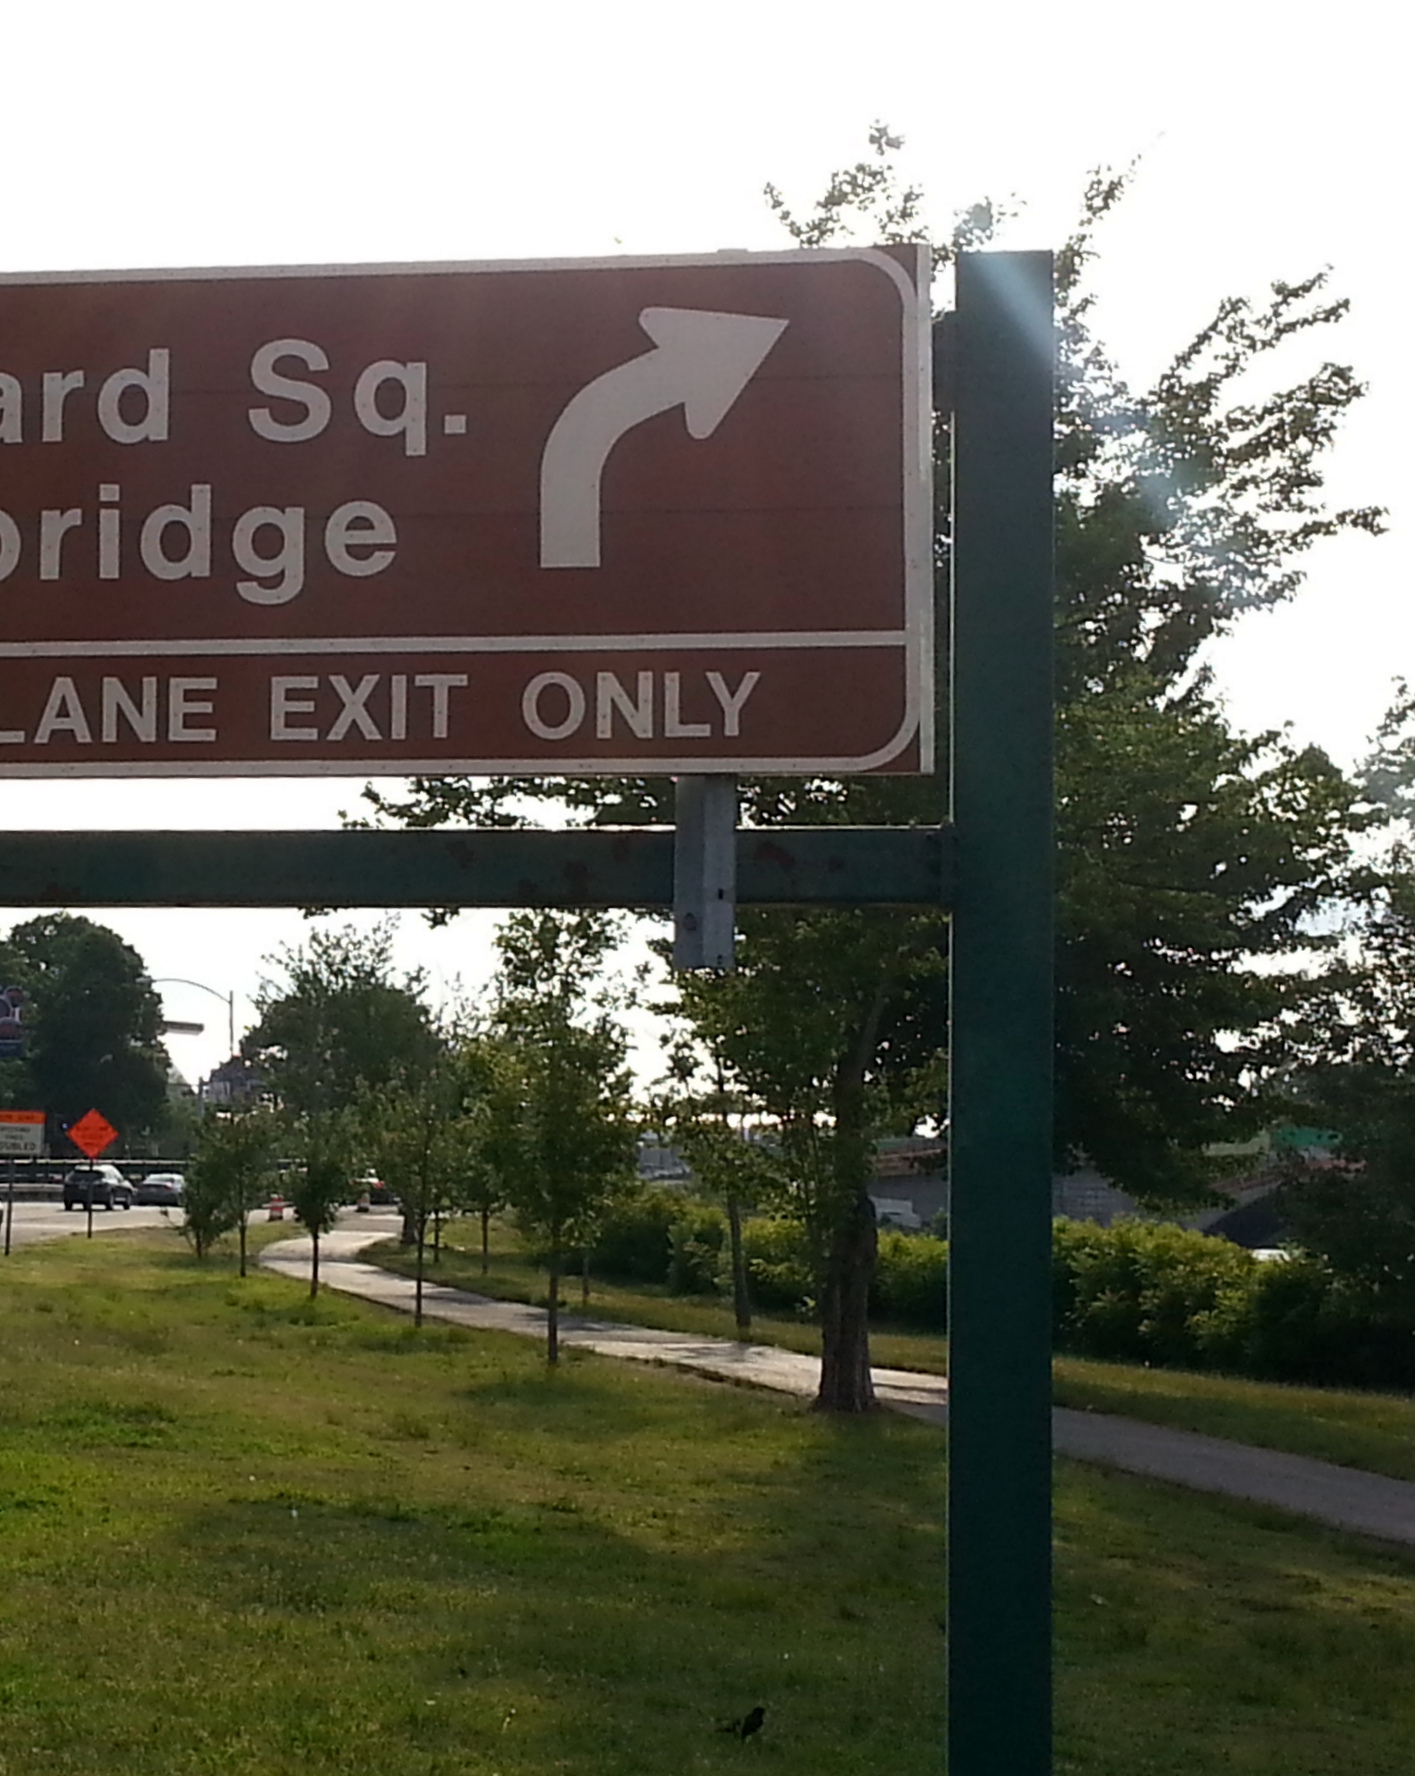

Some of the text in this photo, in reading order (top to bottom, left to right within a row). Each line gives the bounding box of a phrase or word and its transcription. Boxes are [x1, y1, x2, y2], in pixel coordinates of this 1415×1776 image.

[248, 337, 467, 458] Sq.
[268, 674, 469, 743] EXIT
[521, 670, 761, 740] ONLY
